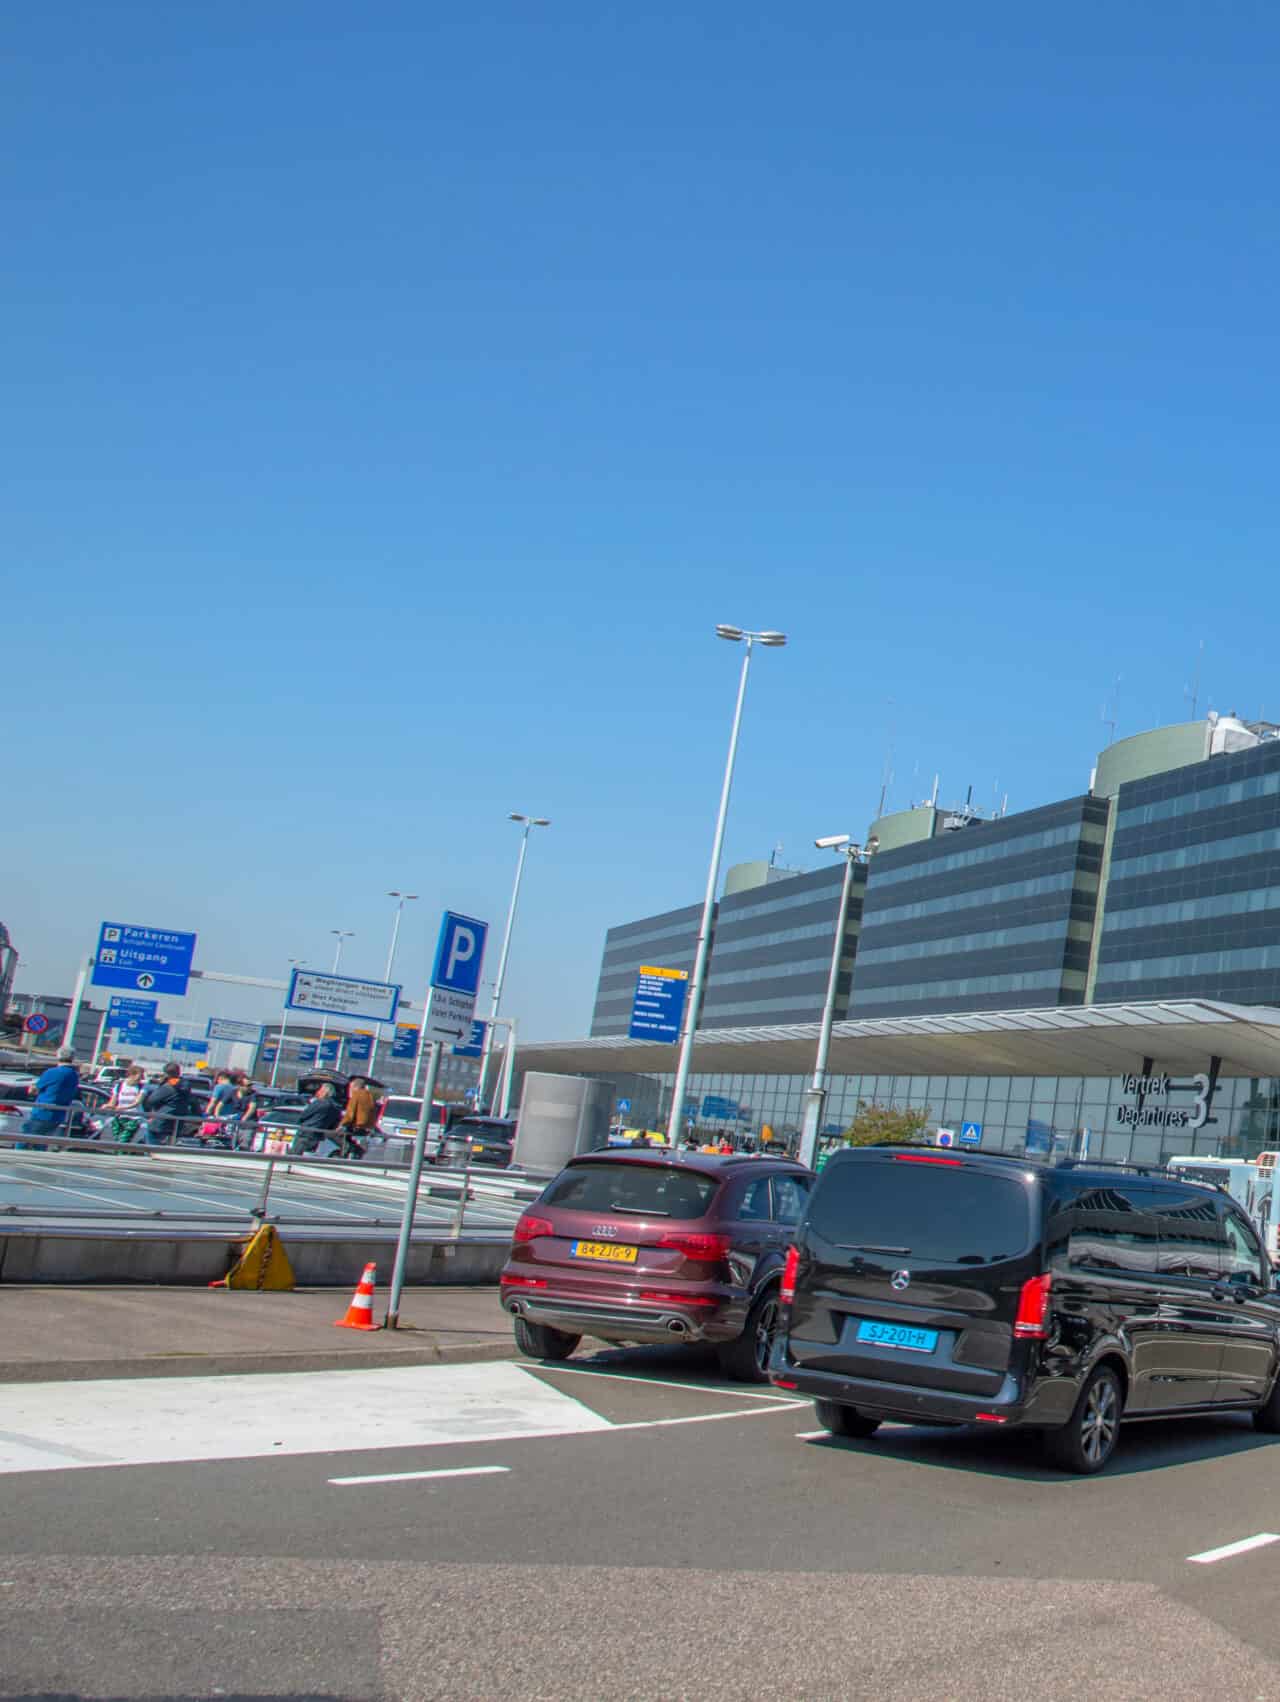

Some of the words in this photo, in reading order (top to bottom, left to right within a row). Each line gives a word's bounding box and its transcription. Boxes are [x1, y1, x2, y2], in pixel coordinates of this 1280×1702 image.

[124, 927, 179, 944] Parkeren
[120, 949, 168, 964] Uitgang
[446, 925, 475, 980] P
[1121, 1072, 1169, 1096] Vertrek
[1188, 1073, 1210, 1128] 3
[1118, 1104, 1188, 1129] Departures
[868, 1325, 927, 1345] SJ-201-H
